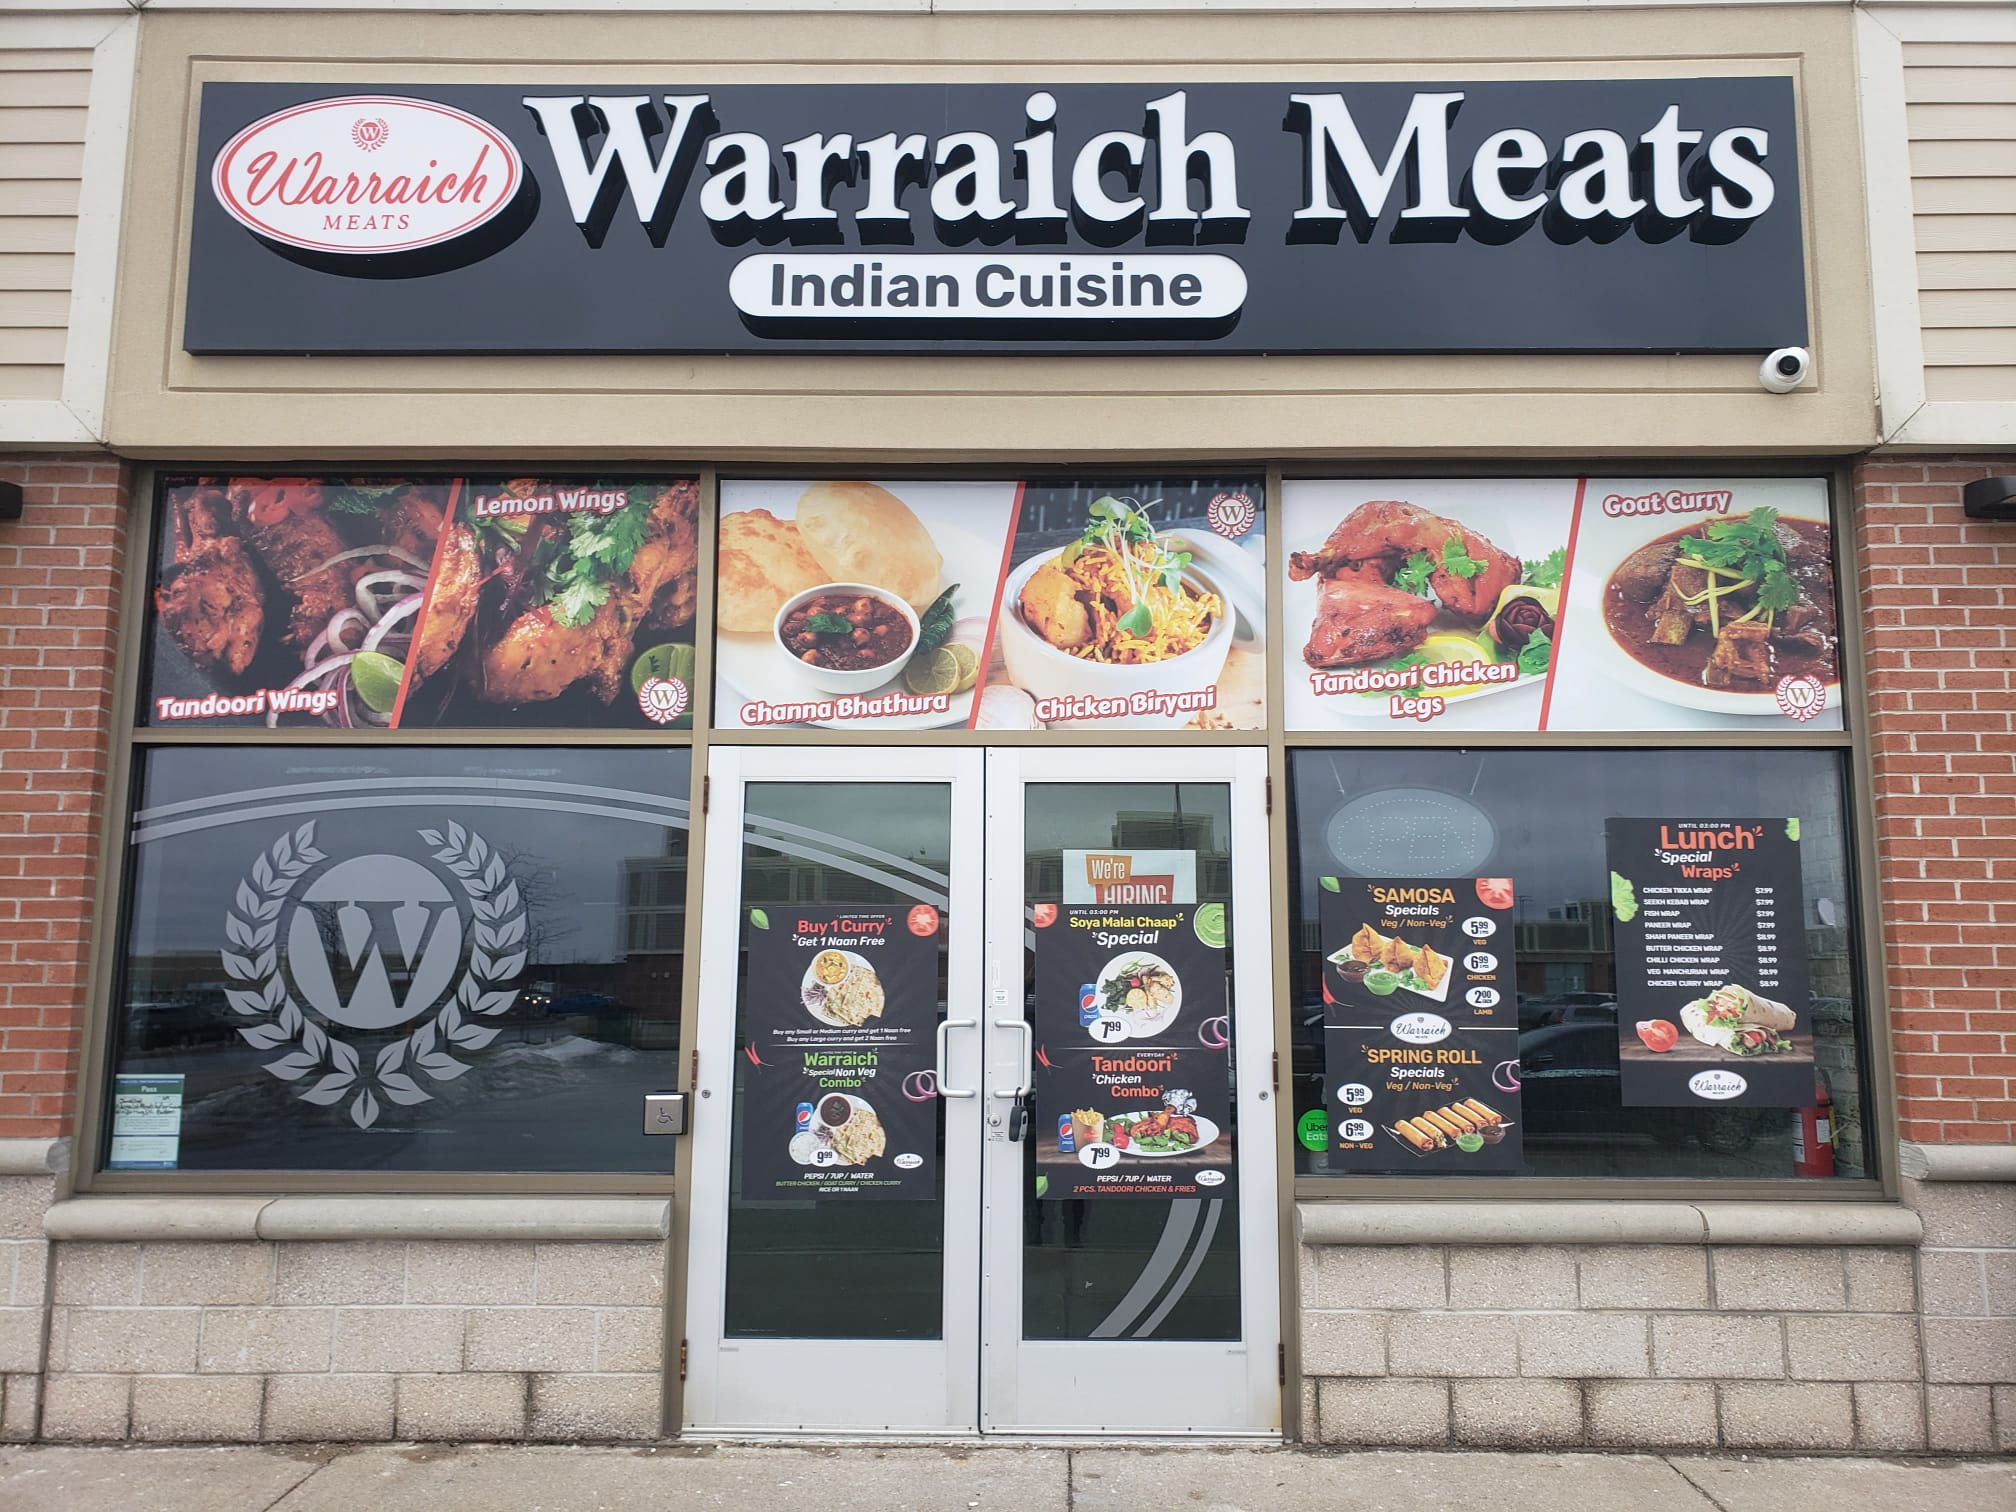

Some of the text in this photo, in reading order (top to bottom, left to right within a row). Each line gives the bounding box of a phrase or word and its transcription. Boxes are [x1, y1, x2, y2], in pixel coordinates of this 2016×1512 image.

[522, 89, 1776, 225] Warraich Meats
[246, 144, 488, 206] Warraich
[323, 214, 410, 231] MEATS
[771, 261, 1203, 308] Indian Cuisine
[476, 490, 627, 517] Lemon Wings
[1603, 491, 1731, 517] Goat Curry
[1310, 663, 1516, 695] Tandoori Chicken
[158, 689, 338, 720] Tandoori Wings
[740, 692, 949, 725] Channa Bhathura
[1034, 686, 1215, 722] Chicken Biryani
[1390, 695, 1444, 722] Legs
[1660, 825, 1755, 850] Lunch
[1660, 851, 1713, 865] Special
[1091, 857, 1125, 880] We're
[1681, 865, 1733, 881] Wraps
[1373, 887, 1456, 904] SAMOSA
[1385, 905, 1440, 917] Specials
[798, 919, 885, 936] Buy 1 Curry
[1070, 916, 1177, 929] Soya Malai Chaap
[1380, 919, 1398, 929] Veg
[1406, 918, 1447, 929] Non-Veg
[797, 936, 885, 947] Get 1 Naan Free
[1096, 930, 1159, 948] Special
[297, 900, 457, 1009] W
[1396, 1022, 1447, 1035] Warraich
[804, 1051, 877, 1066] Warraich
[1091, 1056, 1171, 1072] Tandoori
[1367, 1049, 1482, 1064] SPRING ROLL
[808, 1067, 876, 1078] Special Non Veg
[1096, 1074, 1141, 1085] Chicken
[1390, 1067, 1445, 1079] Specials
[819, 1077, 861, 1088] Combo
[1111, 1085, 1160, 1097] Combo
[1386, 1082, 1403, 1091] Veg
[1412, 1081, 1453, 1091] Non-Veg
